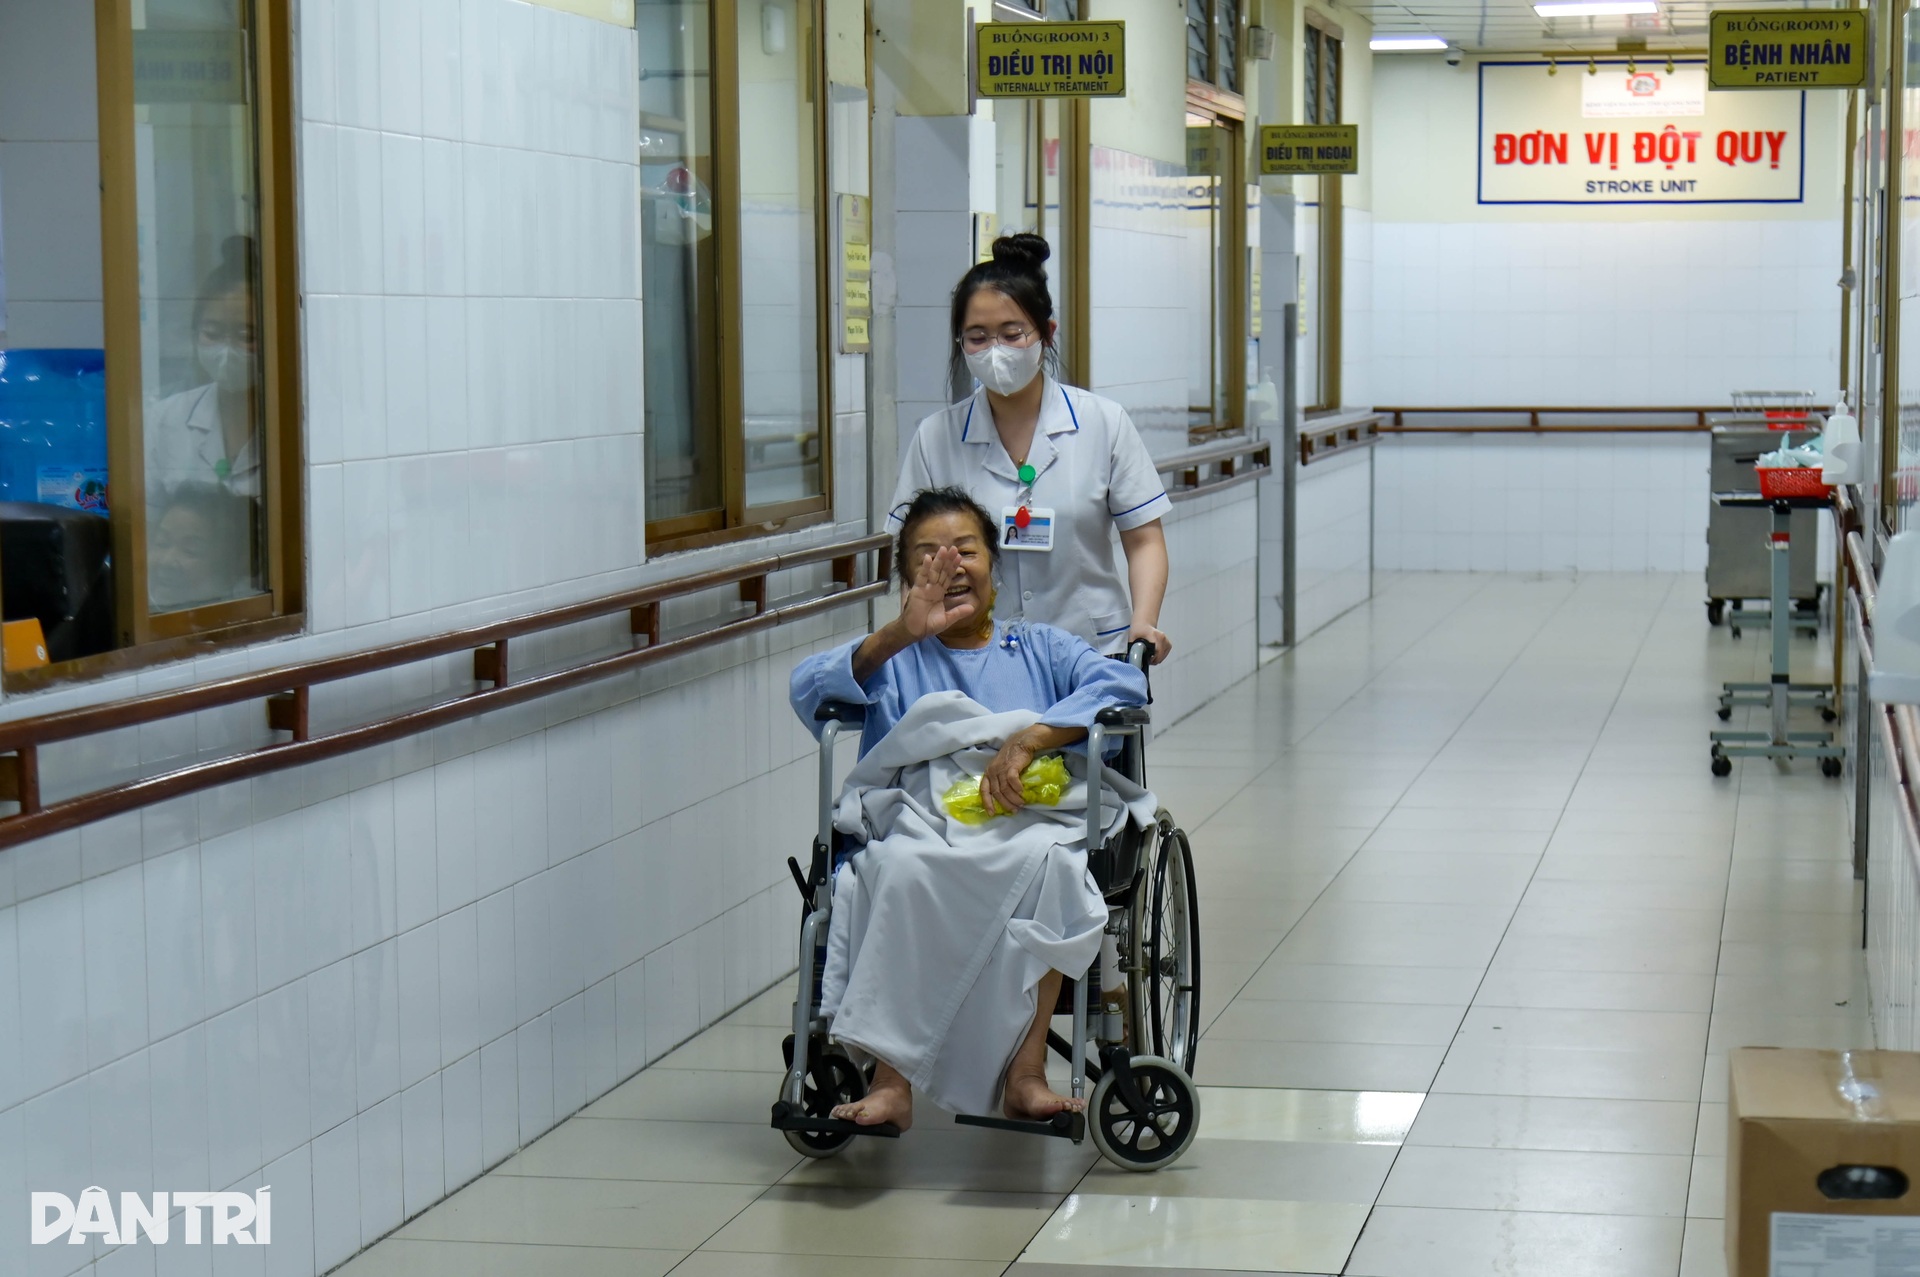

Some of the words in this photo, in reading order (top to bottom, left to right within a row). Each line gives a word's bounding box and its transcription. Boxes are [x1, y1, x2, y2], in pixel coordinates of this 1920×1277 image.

[1843, 20, 1850, 31] 9
[1102, 32, 1110, 42] 3
[1725, 40, 1782, 70] BỆNH
[1790, 39, 1850, 64] NHÂN
[988, 48, 1034, 76] ĐIỀU
[1041, 55, 1072, 79] TRỊ
[1079, 50, 1113, 79] NỘI
[1756, 72, 1819, 82] PATIENT
[994, 82, 1050, 92] INTERNALLY
[1054, 82, 1108, 92] TREATMENT
[1494, 130, 1568, 165] ĐƠN
[1585, 133, 1618, 170] VỊ
[1634, 124, 1702, 170] ĐỘT
[1716, 131, 1787, 169] QUỴ
[1296, 146, 1313, 162] TRỊ
[1317, 146, 1352, 162] NGOẠI
[1586, 180, 1654, 193] STROKE
[1661, 180, 1697, 192] UNIT
